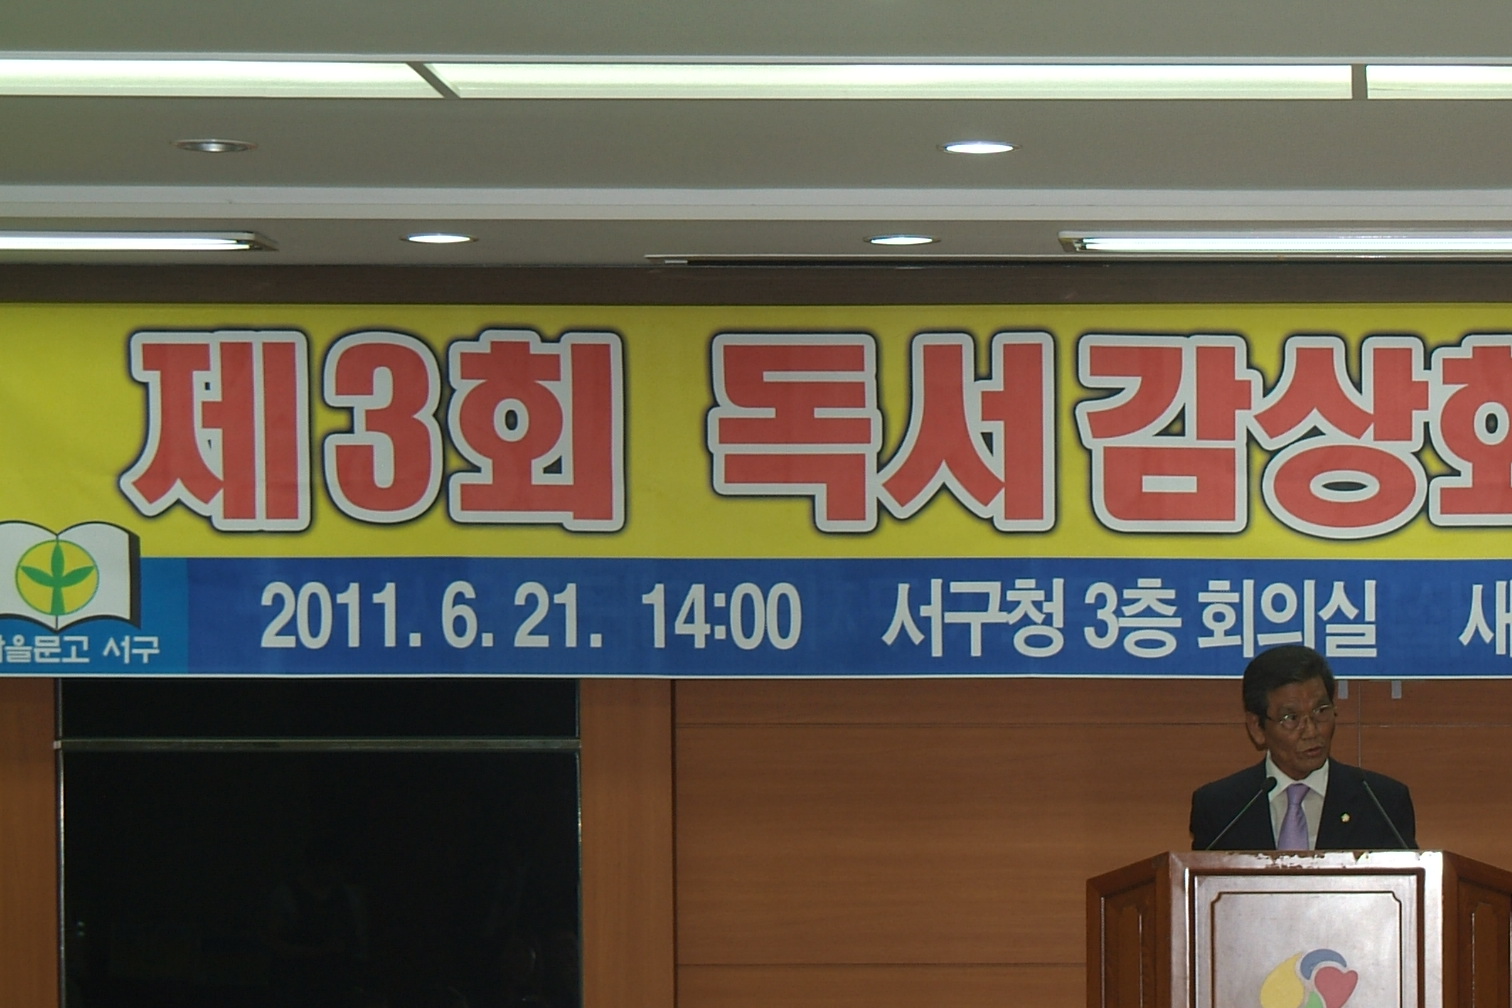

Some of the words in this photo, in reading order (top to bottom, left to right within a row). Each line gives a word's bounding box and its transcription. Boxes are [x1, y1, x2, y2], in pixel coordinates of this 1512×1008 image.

[120, 330, 624, 532] 제3회
[0, 634, 90, 664] 을문고
[103, 635, 160, 664] 서구
[260, 581, 422, 650] 2011.
[441, 580, 494, 649] 6.
[514, 581, 603, 648] 21.
[641, 582, 802, 650] 14:00
[881, 577, 1065, 658] 서구청
[1083, 578, 1183, 659] 3층
[1197, 578, 1377, 658] 회의실
